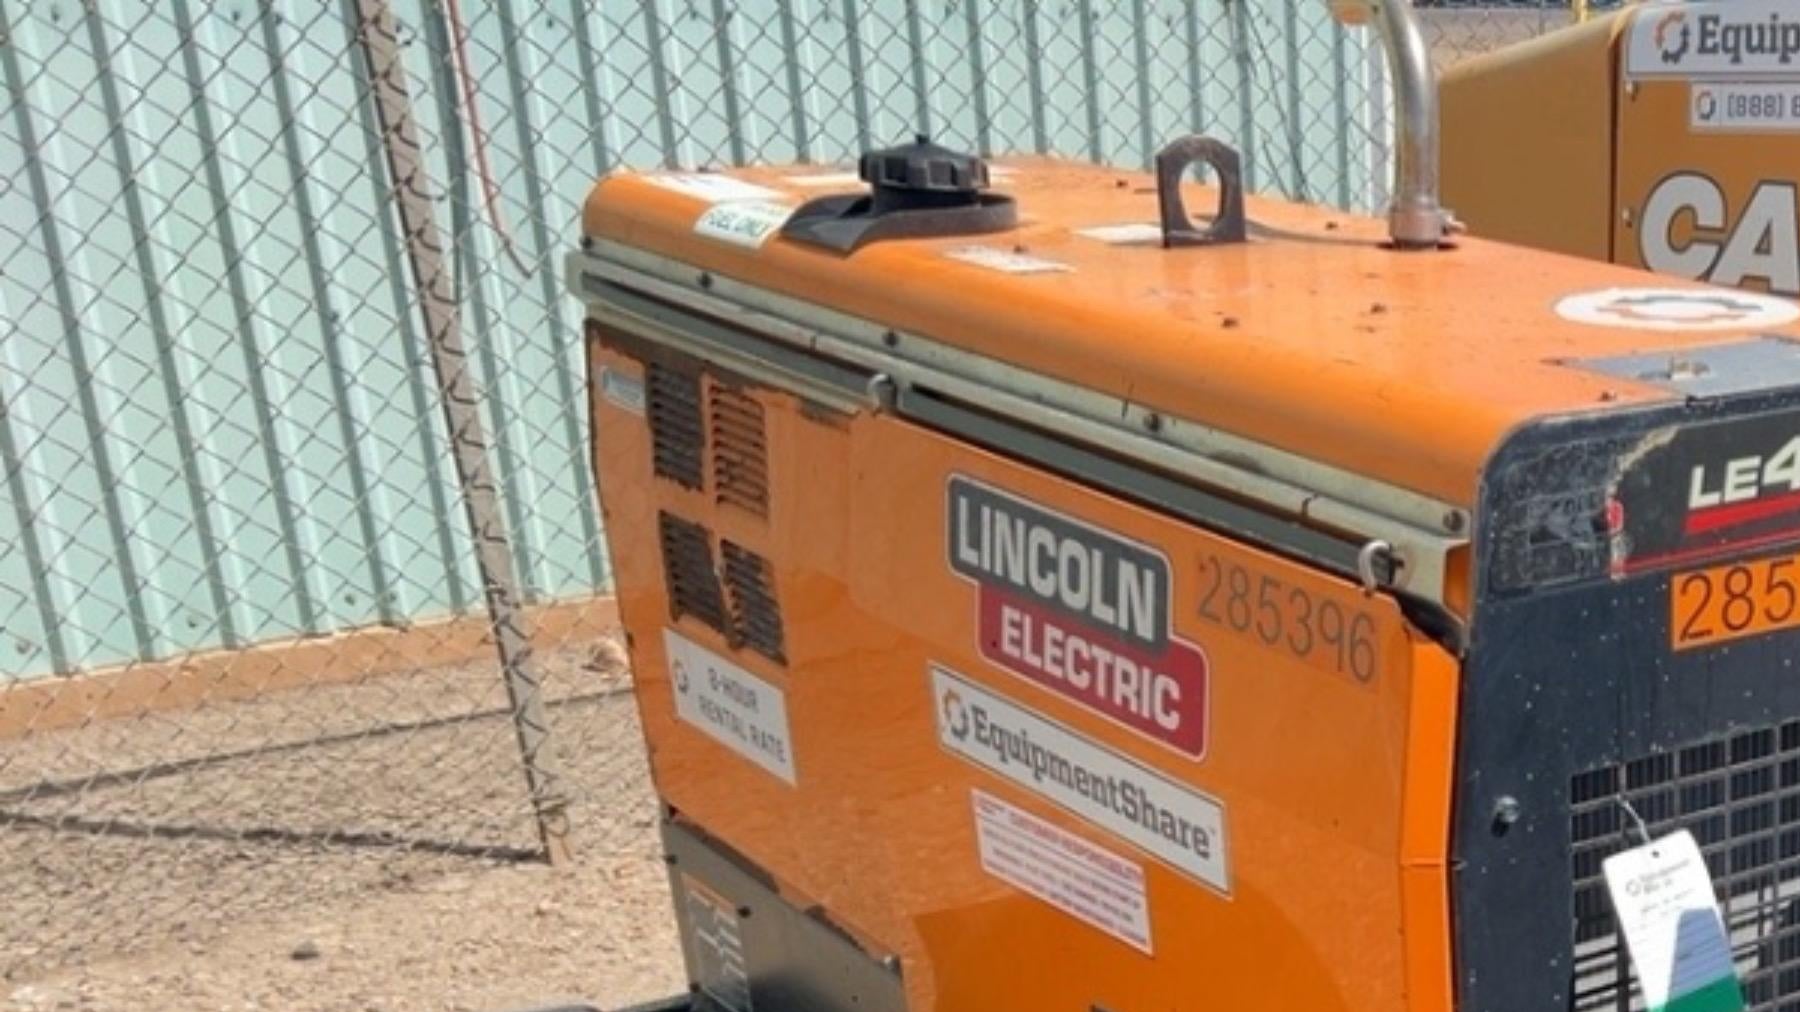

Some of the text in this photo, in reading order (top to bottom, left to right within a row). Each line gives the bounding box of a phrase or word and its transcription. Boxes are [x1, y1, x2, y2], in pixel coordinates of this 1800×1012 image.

[1726, 92, 1784, 121] (888)
[958, 496, 1156, 643] LINCOLN
[1198, 555, 1376, 684] 285396
[1001, 604, 1182, 732] ELECTRIC
[970, 703, 1212, 860] EquipmentShare
